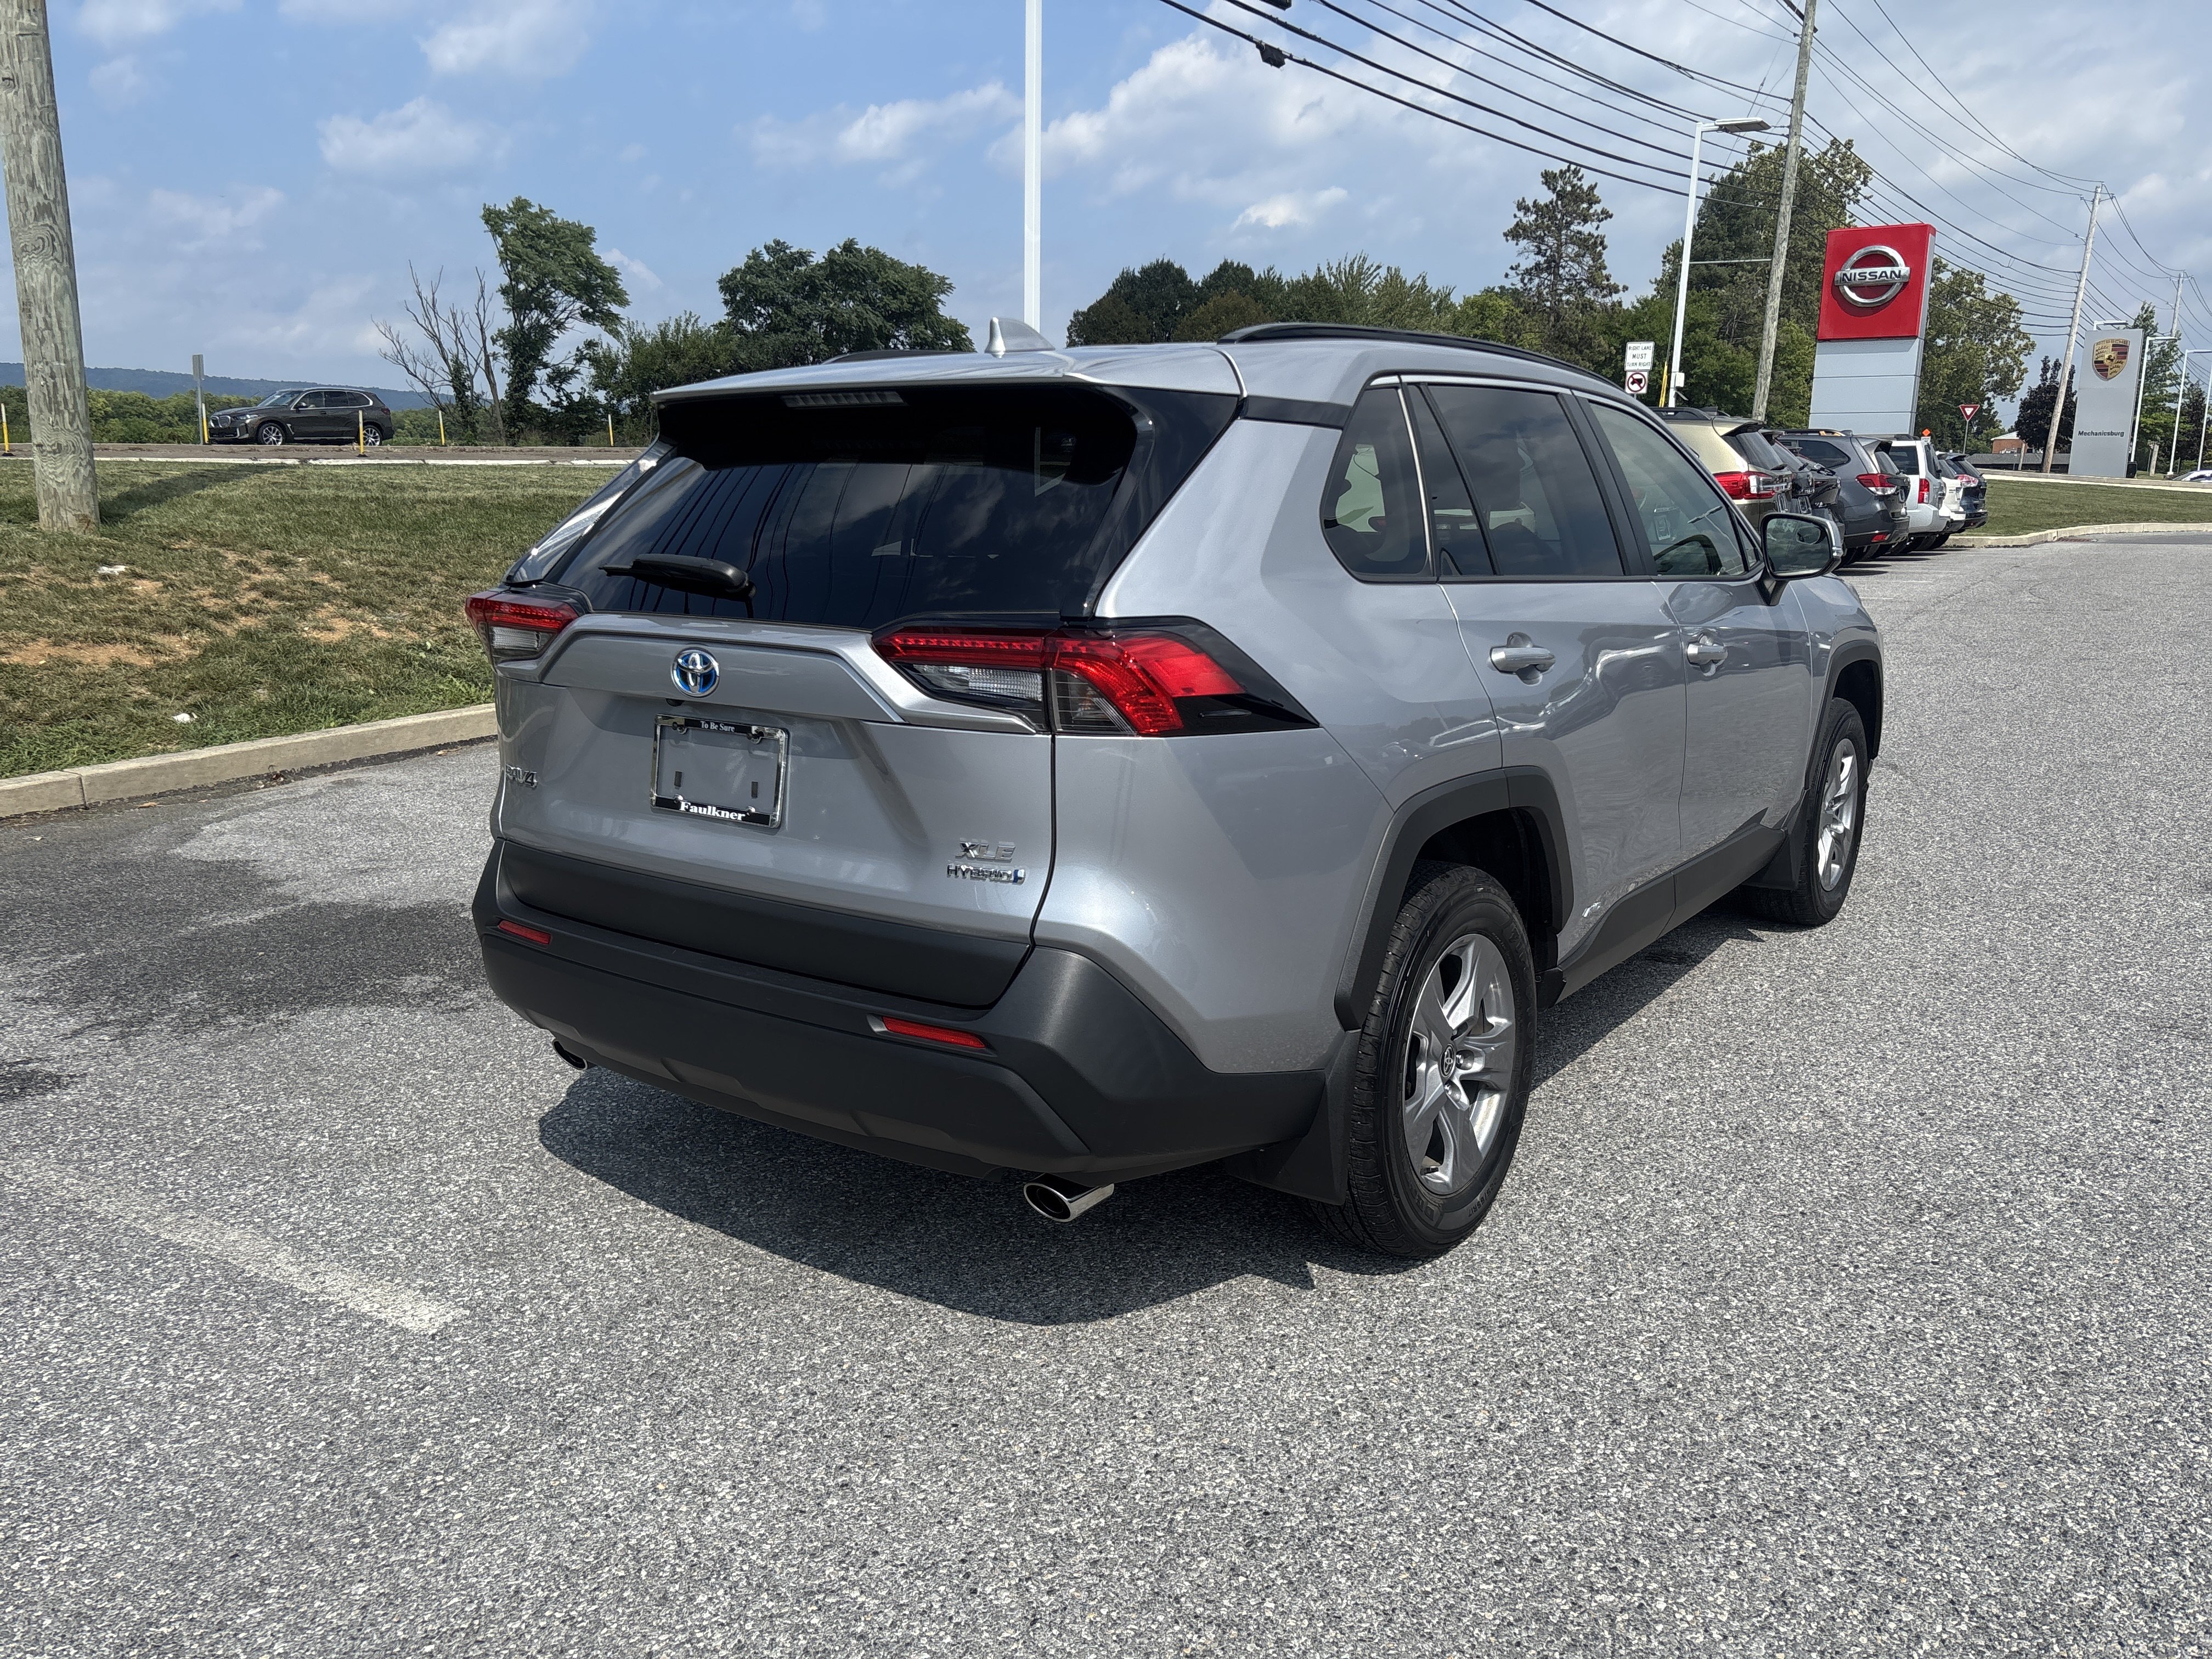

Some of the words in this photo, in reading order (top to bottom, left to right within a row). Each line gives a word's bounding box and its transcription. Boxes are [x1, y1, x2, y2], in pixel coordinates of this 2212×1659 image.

[1842, 269, 1901, 283] NISSAN
[700, 720, 708, 729] To
[710, 722, 719, 730] Be
[719, 723, 735, 732] Sure
[679, 801, 746, 821] Faulkner
[955, 842, 1016, 863] XLE
[947, 863, 1014, 884] HYBRID
